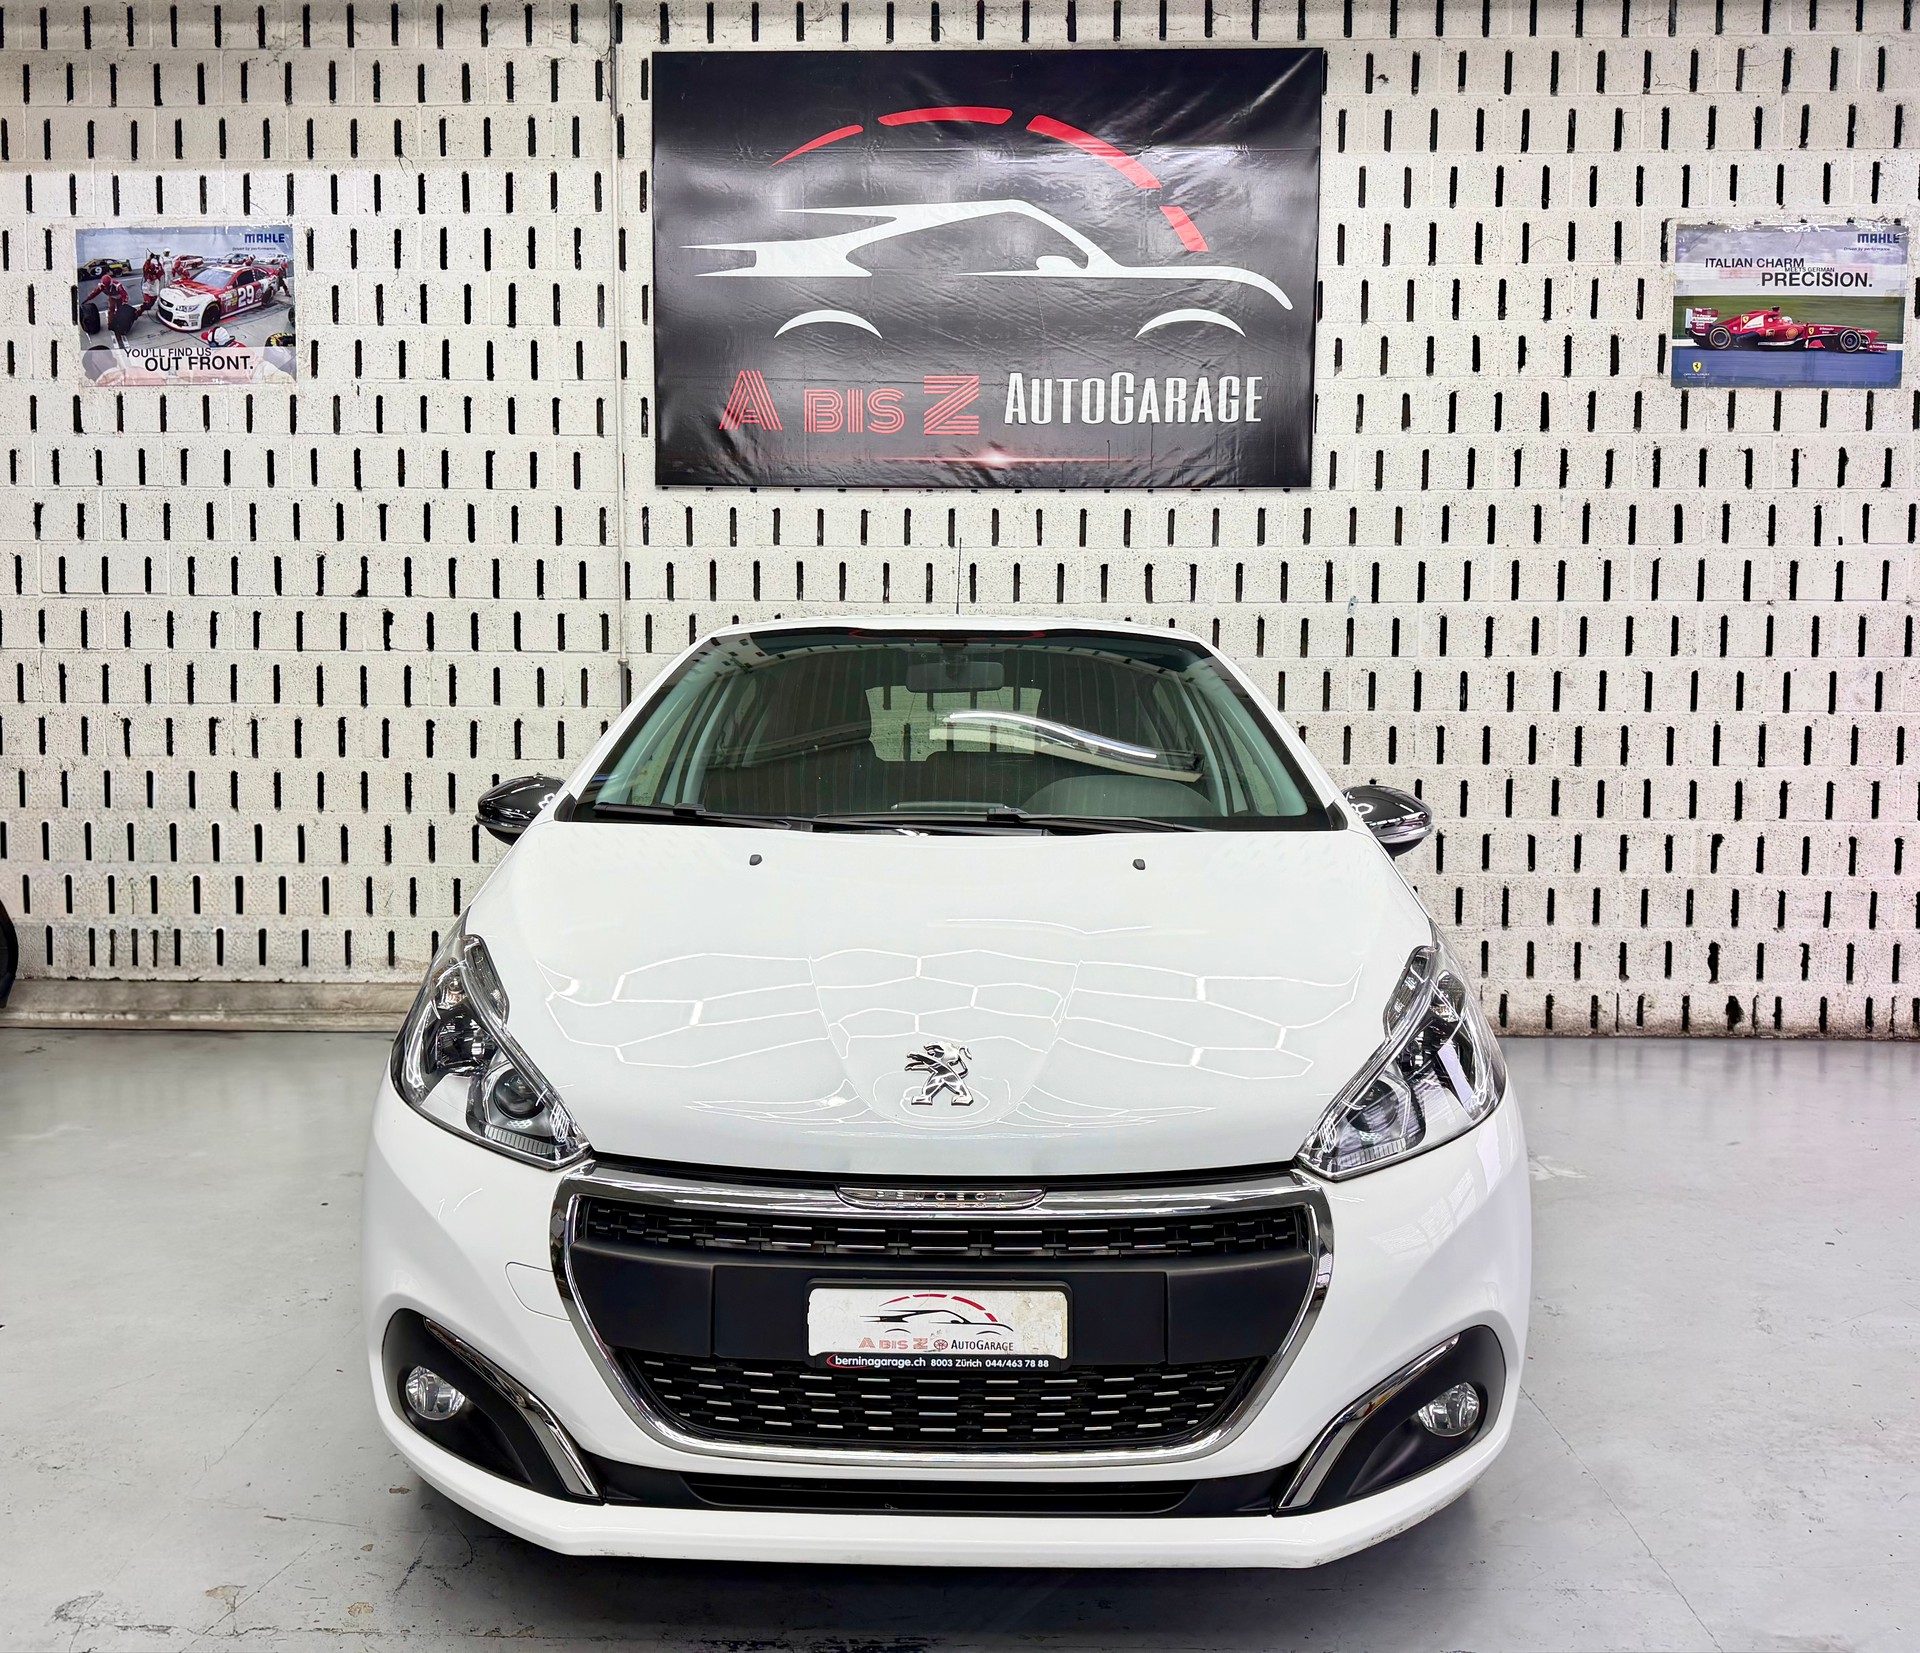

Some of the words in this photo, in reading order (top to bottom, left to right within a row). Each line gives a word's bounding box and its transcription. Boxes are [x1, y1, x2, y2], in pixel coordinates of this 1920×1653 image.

[245, 233, 285, 243] MAHLE
[1857, 233, 1900, 244] MAHLE
[1705, 258, 1753, 268] ITALIAN
[1756, 258, 1804, 268] CHARM
[94, 267, 103, 275] 9
[1761, 273, 1873, 287] PRECISION.
[237, 286, 255, 307] 29
[125, 349, 166, 358] YOU'LL
[168, 348, 193, 357] FIND
[196, 348, 212, 357] US
[145, 357, 183, 372] OUT
[188, 355, 254, 371] FRONT.
[718, 369, 783, 431] A
[803, 388, 904, 433] BIS
[923, 375, 980, 435] Z
[859, 1337, 875, 1349] A
[879, 1340, 908, 1350] BIS
[913, 1338, 928, 1350] Z
[835, 1355, 926, 1368] berninagarage.ch
[930, 1359, 953, 1368] 8003
[956, 1359, 982, 1368] Zürich
[985, 1359, 1023, 1369] 044/463
[1025, 1359, 1036, 1368] 78
[1037, 1359, 1049, 1368] 88
